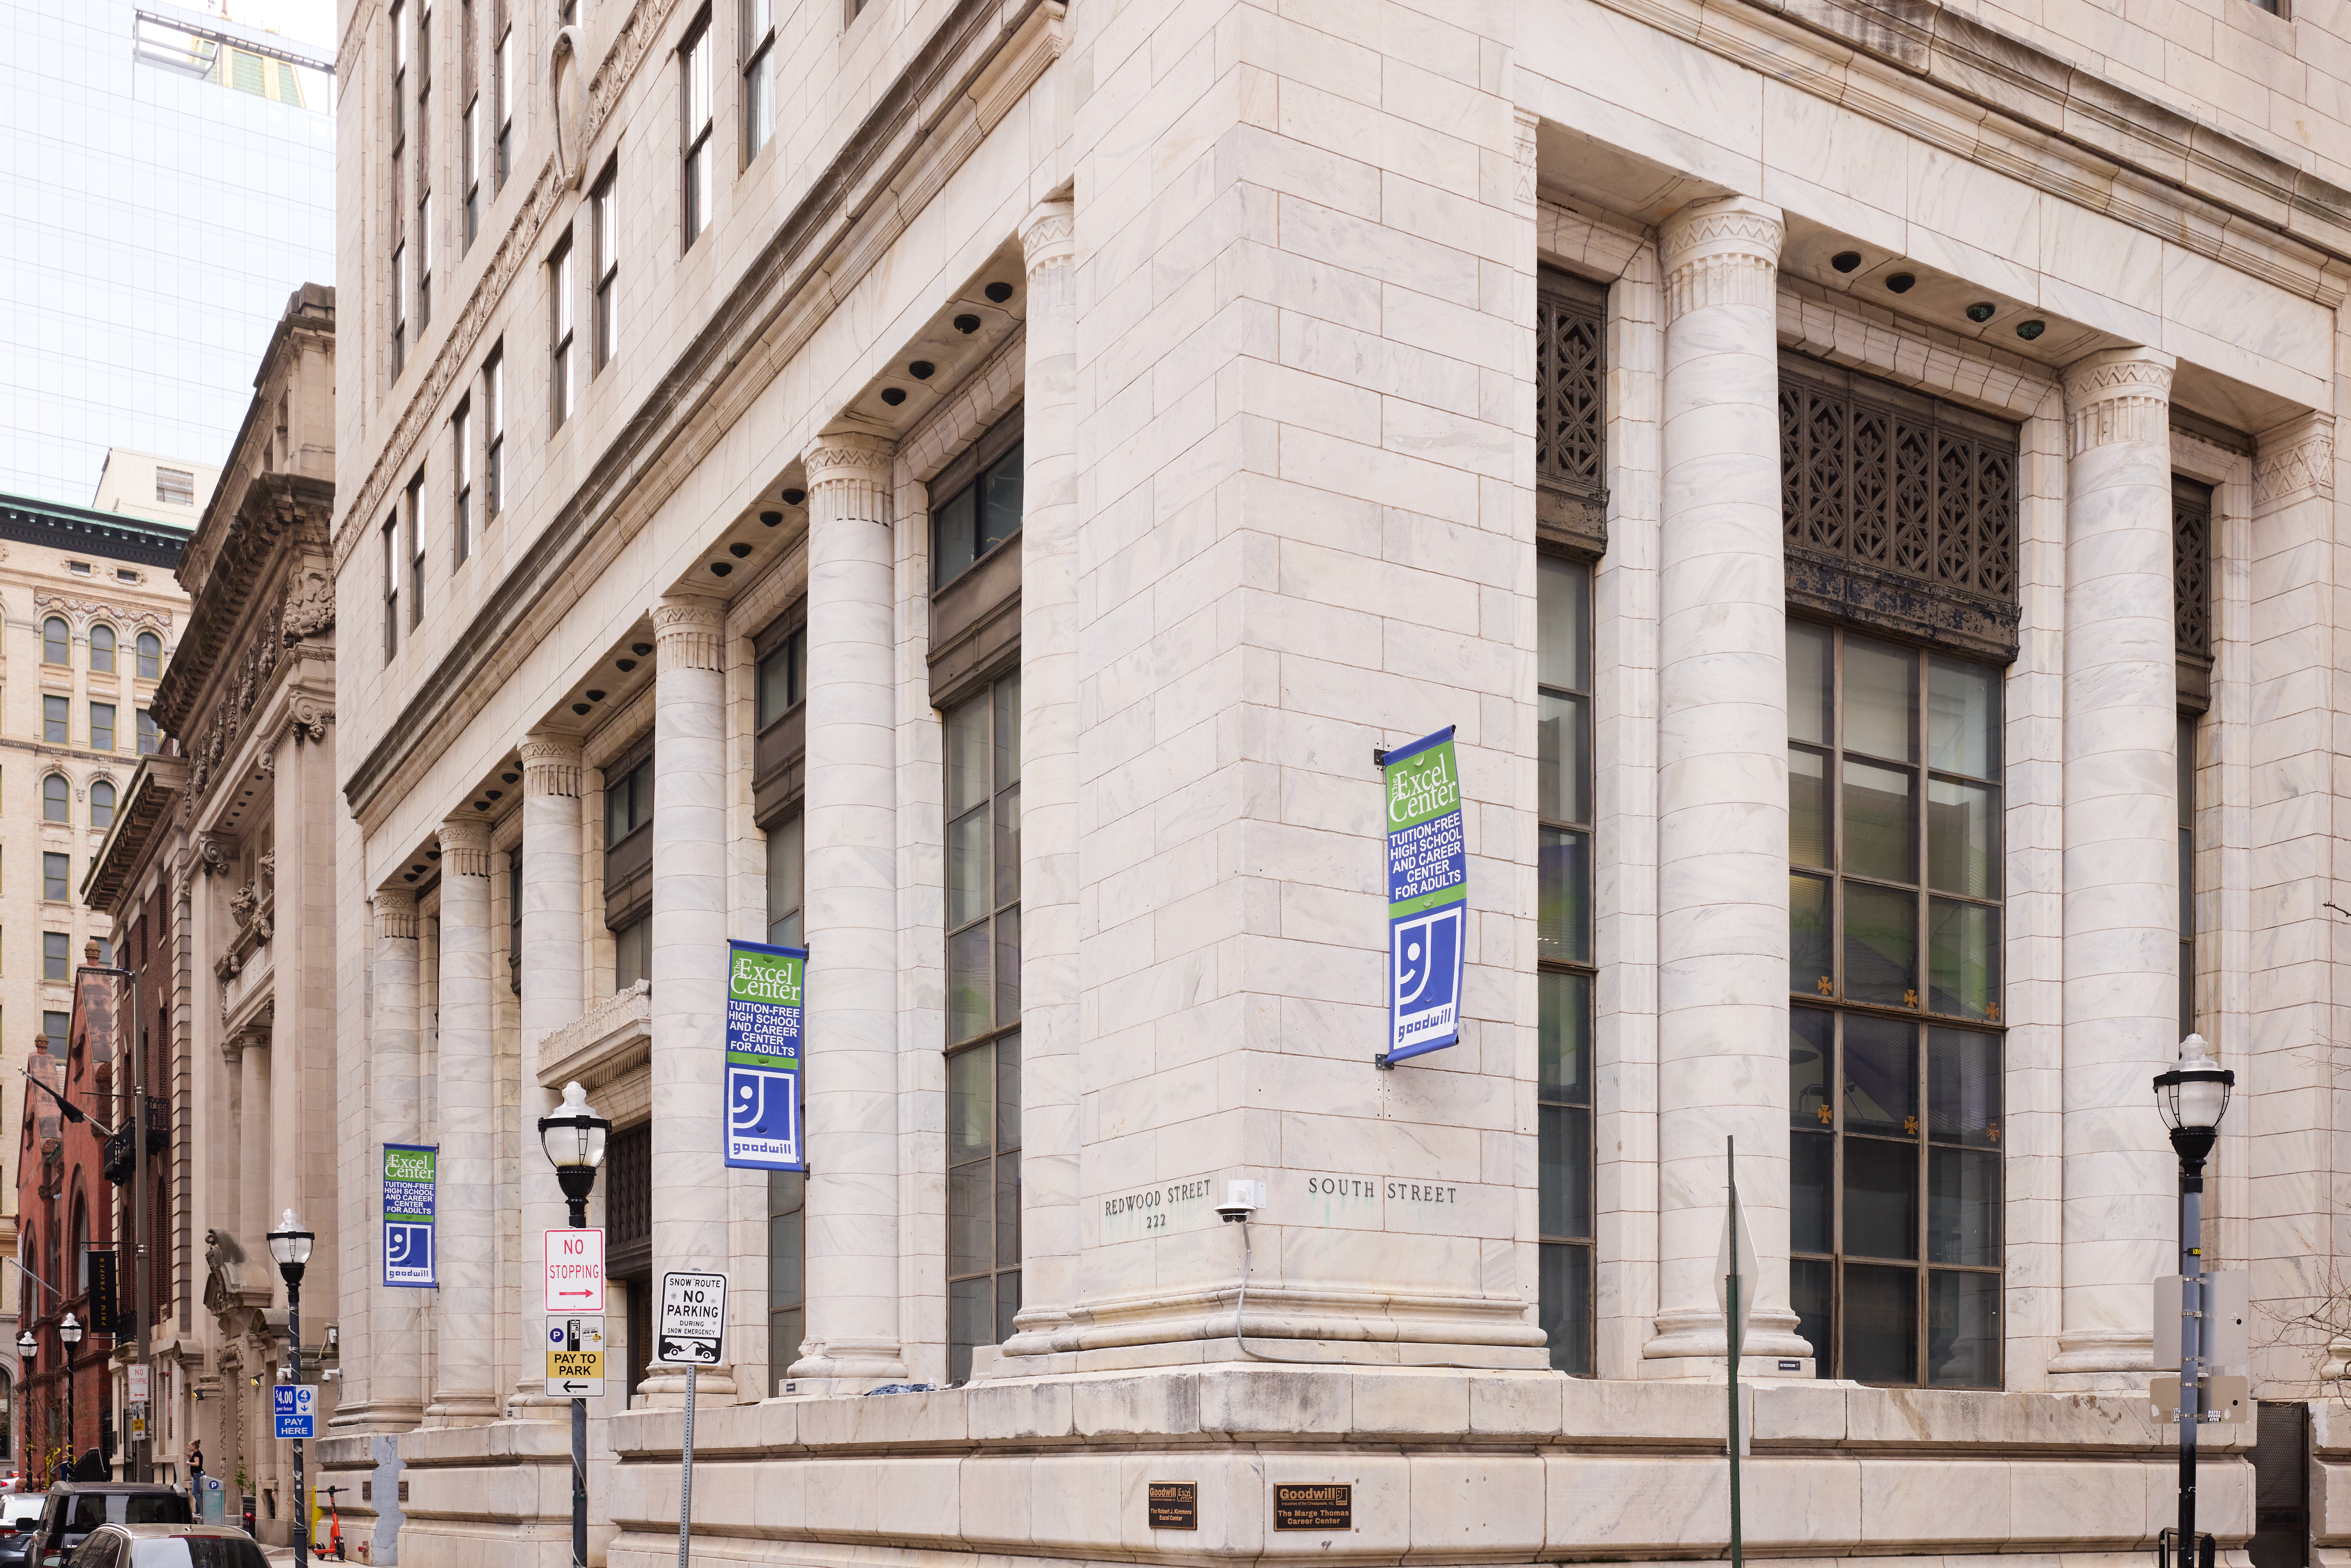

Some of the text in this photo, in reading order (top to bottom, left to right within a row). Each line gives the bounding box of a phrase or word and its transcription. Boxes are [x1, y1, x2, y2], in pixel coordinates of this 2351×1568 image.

[1395, 753, 1448, 801] Excel
[1389, 781, 1456, 822] Center
[1390, 812, 1460, 846] TUITION-FREE
[1391, 827, 1462, 860] HIGH SCHOOL
[1393, 842, 1461, 874] AND CAREER
[1407, 859, 1450, 882] CENTER
[1396, 870, 1460, 899] FOR ADULTS
[738, 958, 793, 985] Excel
[731, 973, 800, 1001] Center
[729, 1001, 800, 1017] TUITION-FREE
[729, 1011, 800, 1027] HIGH SCHOOL
[1397, 1008, 1451, 1042] goodwill
[729, 1021, 797, 1037] AND CAREER
[742, 1032, 783, 1045] CENTER
[731, 1041, 795, 1056] FOR ADULTS
[733, 1142, 791, 1155] goodwill
[390, 1154, 428, 1169] Excel
[385, 1164, 434, 1179] Center
[385, 1181, 434, 1190] TUITION-FREE
[1309, 1178, 1456, 1203] SOUTH STREET
[1105, 1179, 1210, 1216] REDWOOD STREET
[1147, 1214, 1165, 1228] 222
[564, 1239, 584, 1254] NO
[389, 1270, 428, 1278] goodwill
[550, 1264, 599, 1279] STOPPING
[684, 1290, 704, 1303] NO
[667, 1305, 718, 1318] PARKING
[555, 1354, 596, 1363] PAY TO
[559, 1366, 592, 1375] PARK
[276, 1389, 293, 1404] $4.00
[1150, 1487, 1176, 1496] Goodwill
[1280, 1488, 1335, 1499] Goodwill
